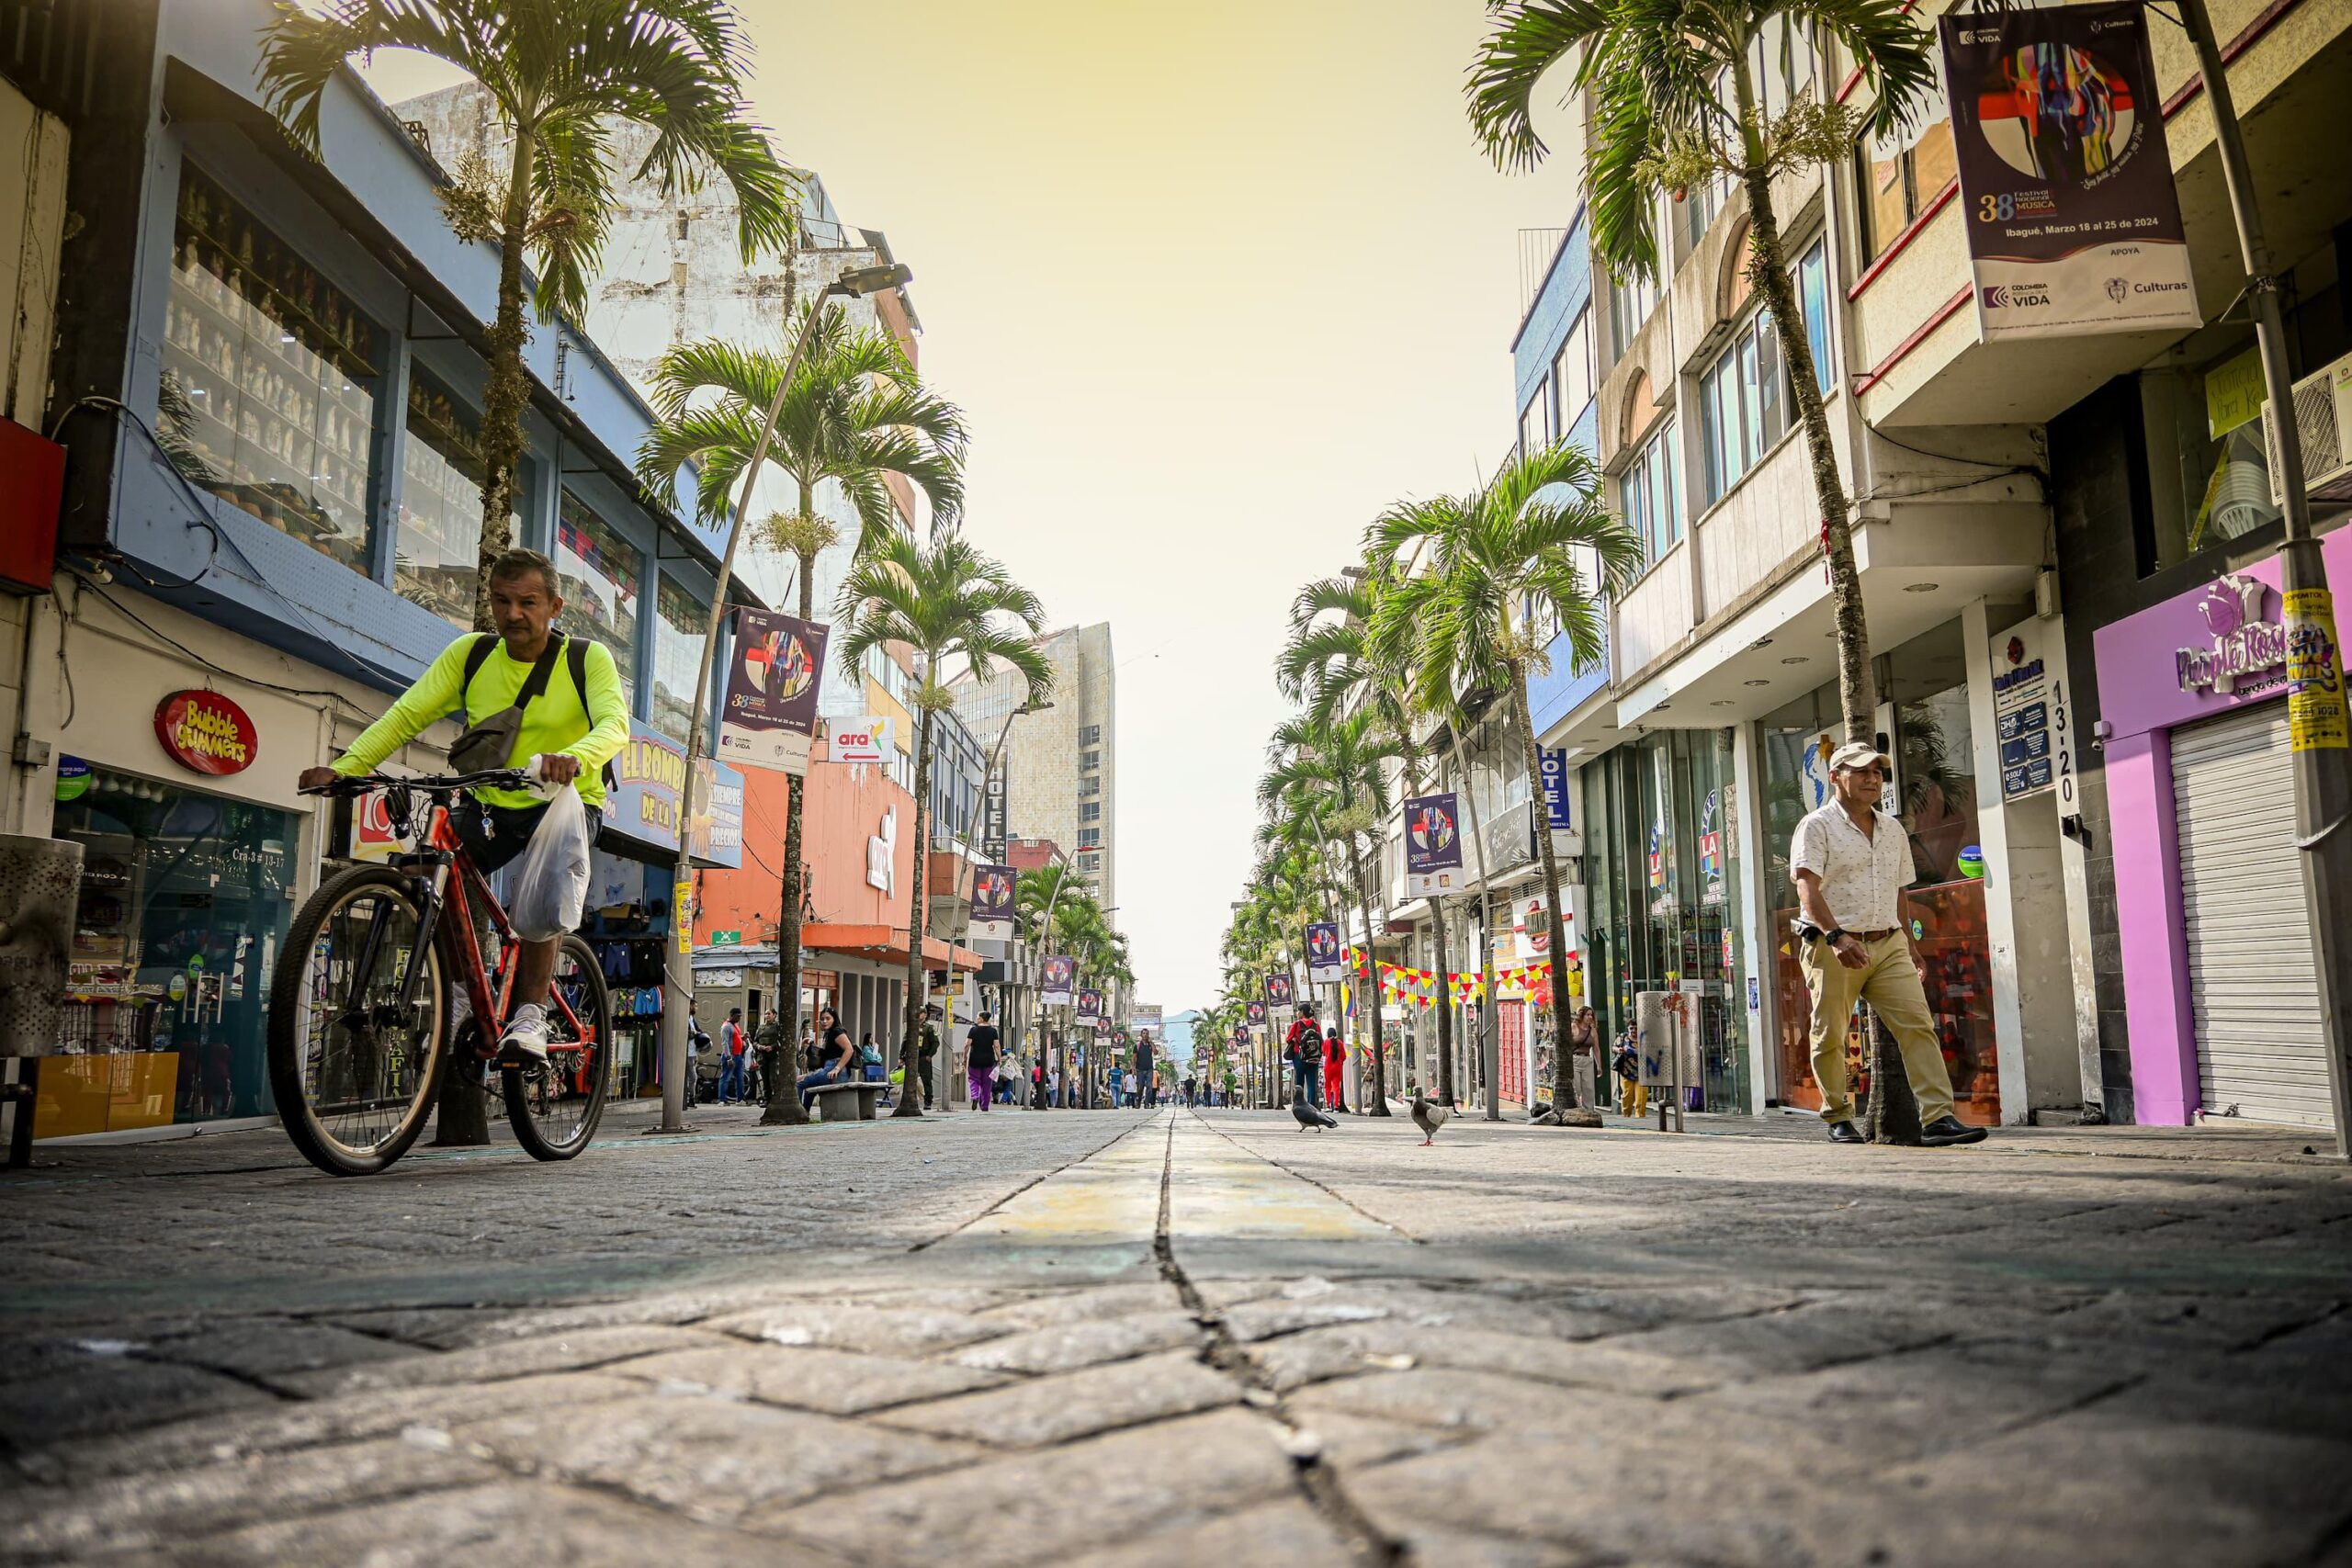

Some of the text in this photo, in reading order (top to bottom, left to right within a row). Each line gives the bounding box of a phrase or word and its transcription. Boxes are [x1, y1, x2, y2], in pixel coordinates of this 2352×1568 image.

[1977, 35, 2001, 43] VIDA
[1978, 193, 2015, 223] 38
[2006, 217, 2159, 238] Ibagué, Marzo 18 al 25 de 2024
[2110, 247, 2141, 256] APOYA
[2011, 283, 2048, 292] COLOMBIA
[2133, 281, 2188, 294] Culturas
[2013, 295, 2051, 308] VIDA
[187, 700, 239, 740] Bubble
[735, 742, 751, 750] VIDA
[838, 734, 868, 746] ara
[2052, 680, 2074, 803] 13-20
[642, 794, 655, 821] DE
[658, 801, 670, 826] LA
[988, 766, 1003, 840] HOTEL
[1702, 835, 1717, 856] LA
